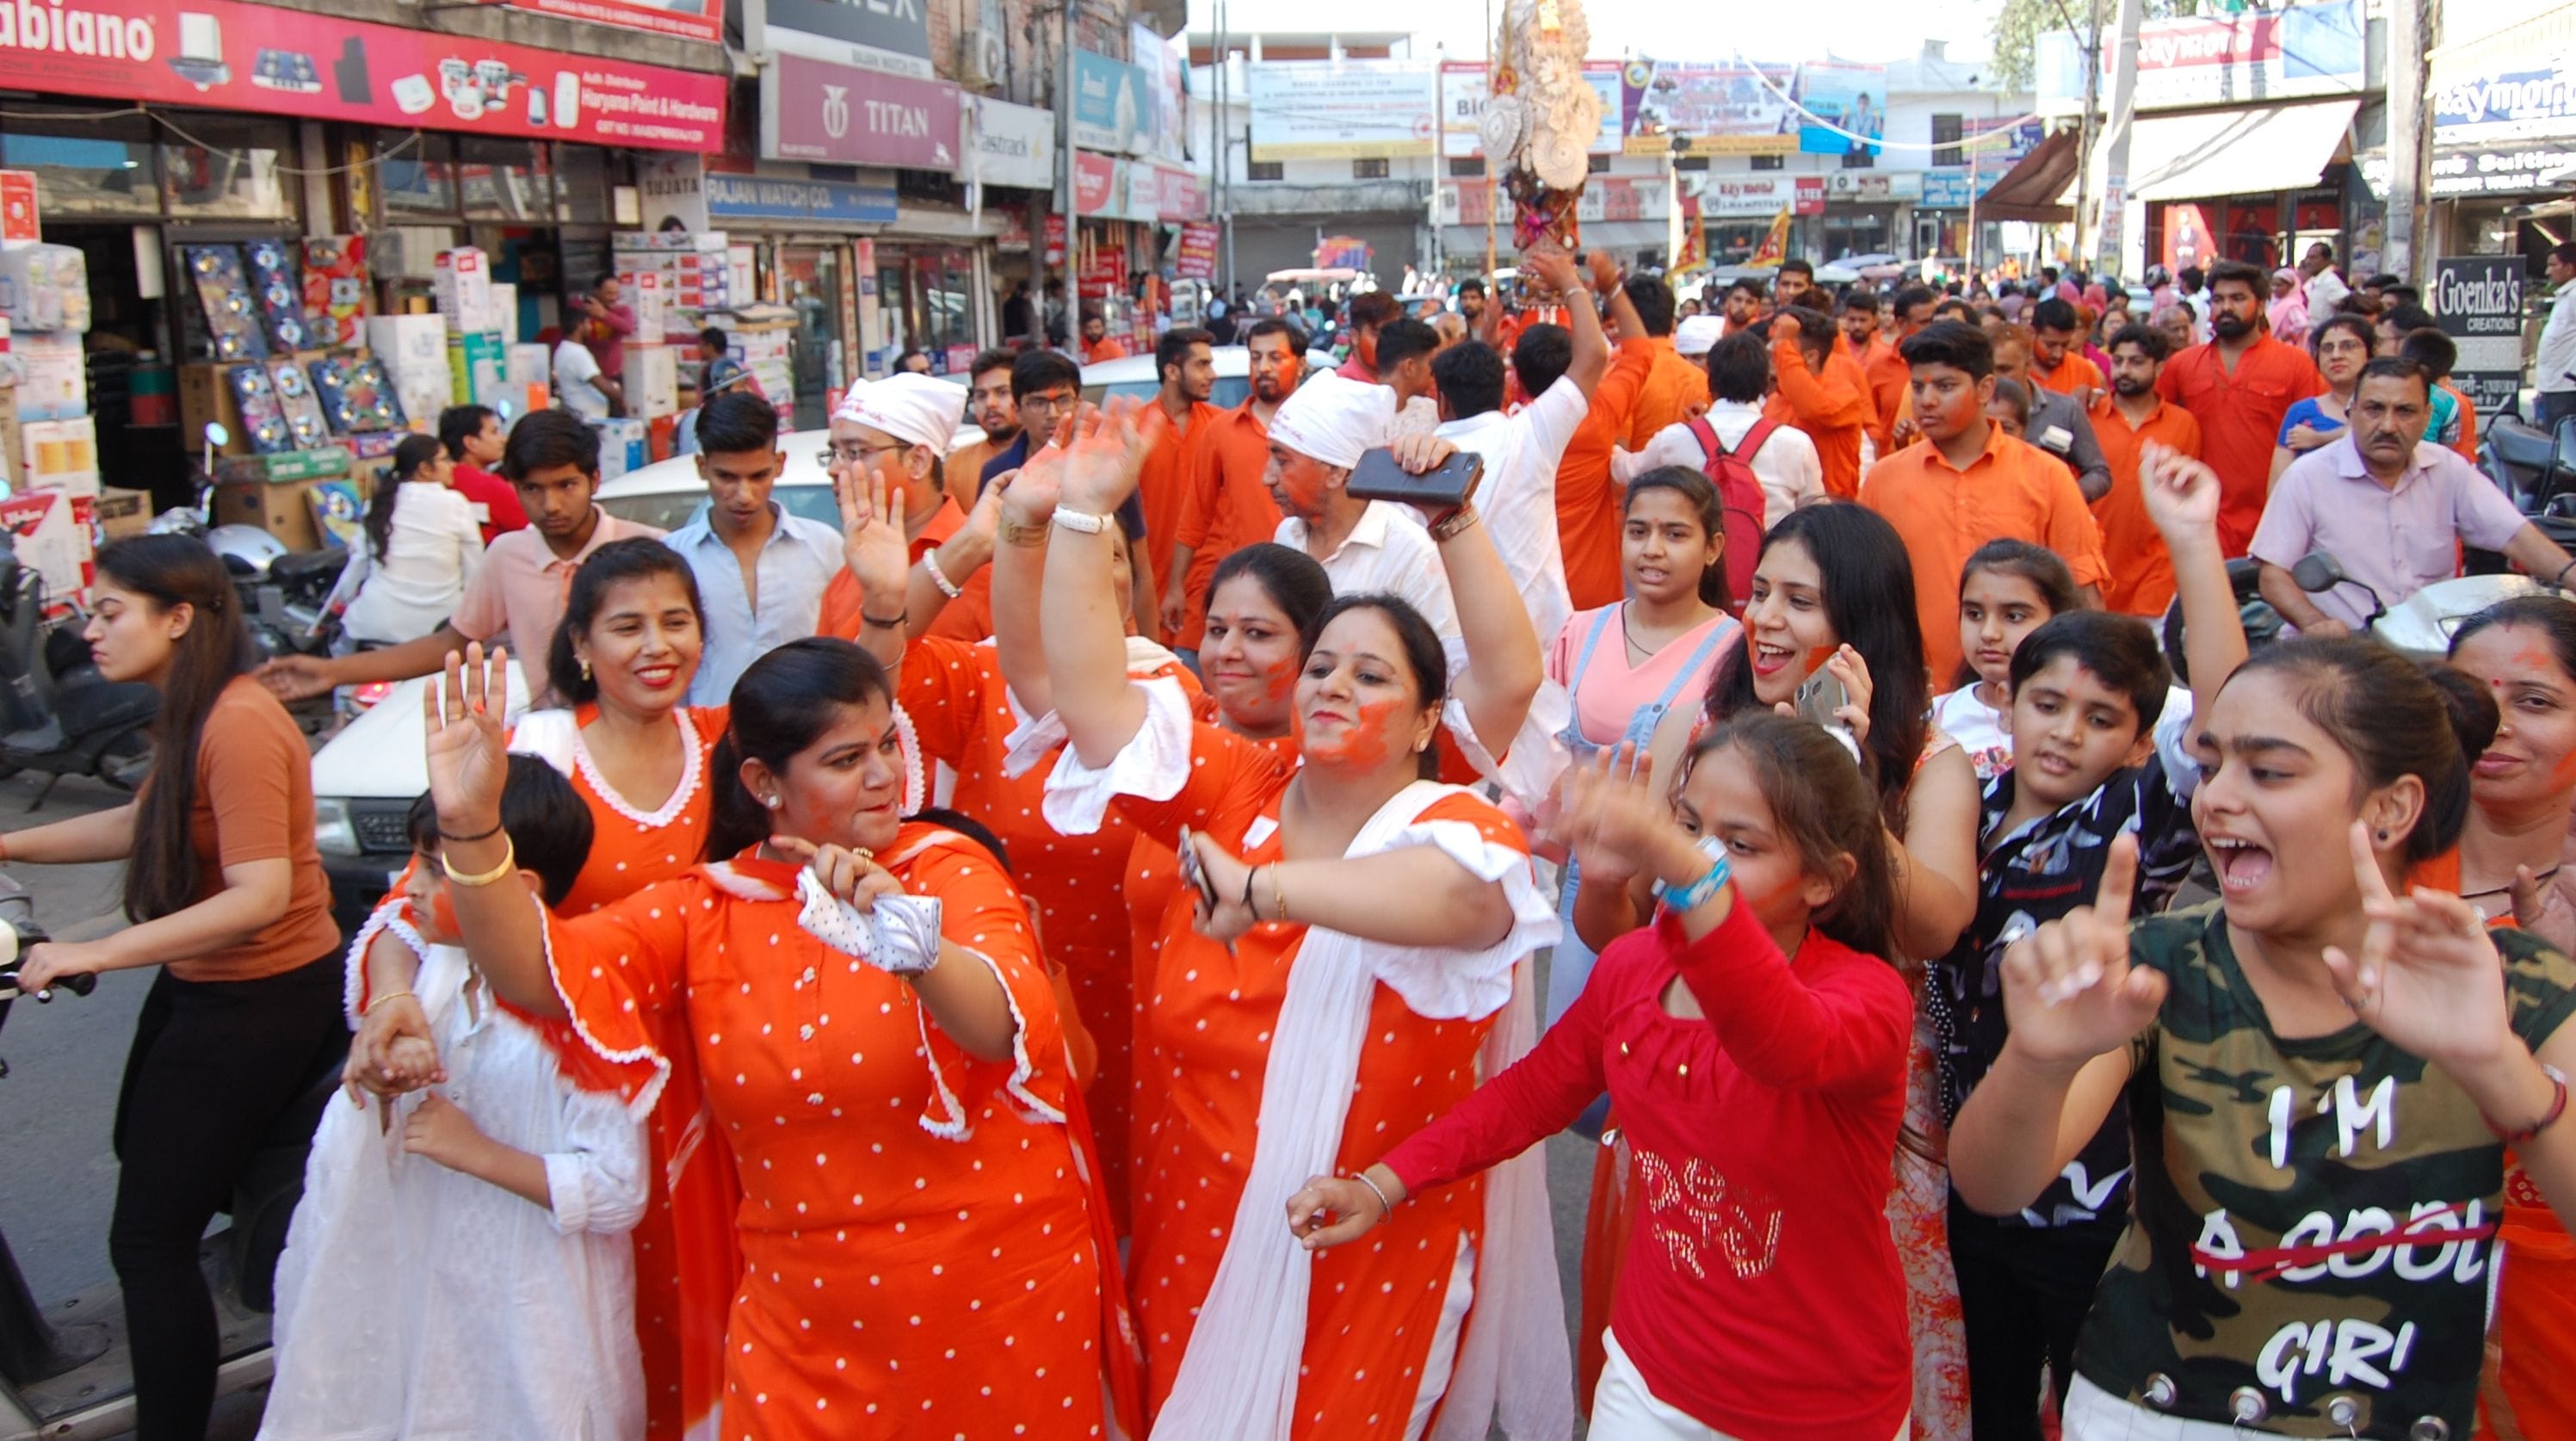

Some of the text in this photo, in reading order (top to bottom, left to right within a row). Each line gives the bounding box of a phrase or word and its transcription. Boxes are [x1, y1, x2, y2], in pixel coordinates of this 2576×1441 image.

[863, 99, 930, 137] TITAN
[979, 133, 1029, 158] astrack
[646, 176, 700, 196] SUJATA
[706, 178, 757, 204] RAJAN
[758, 182, 807, 207] WATCH
[2437, 266, 2520, 316] Goenka's
[2466, 317, 2517, 332] CREATIONS
